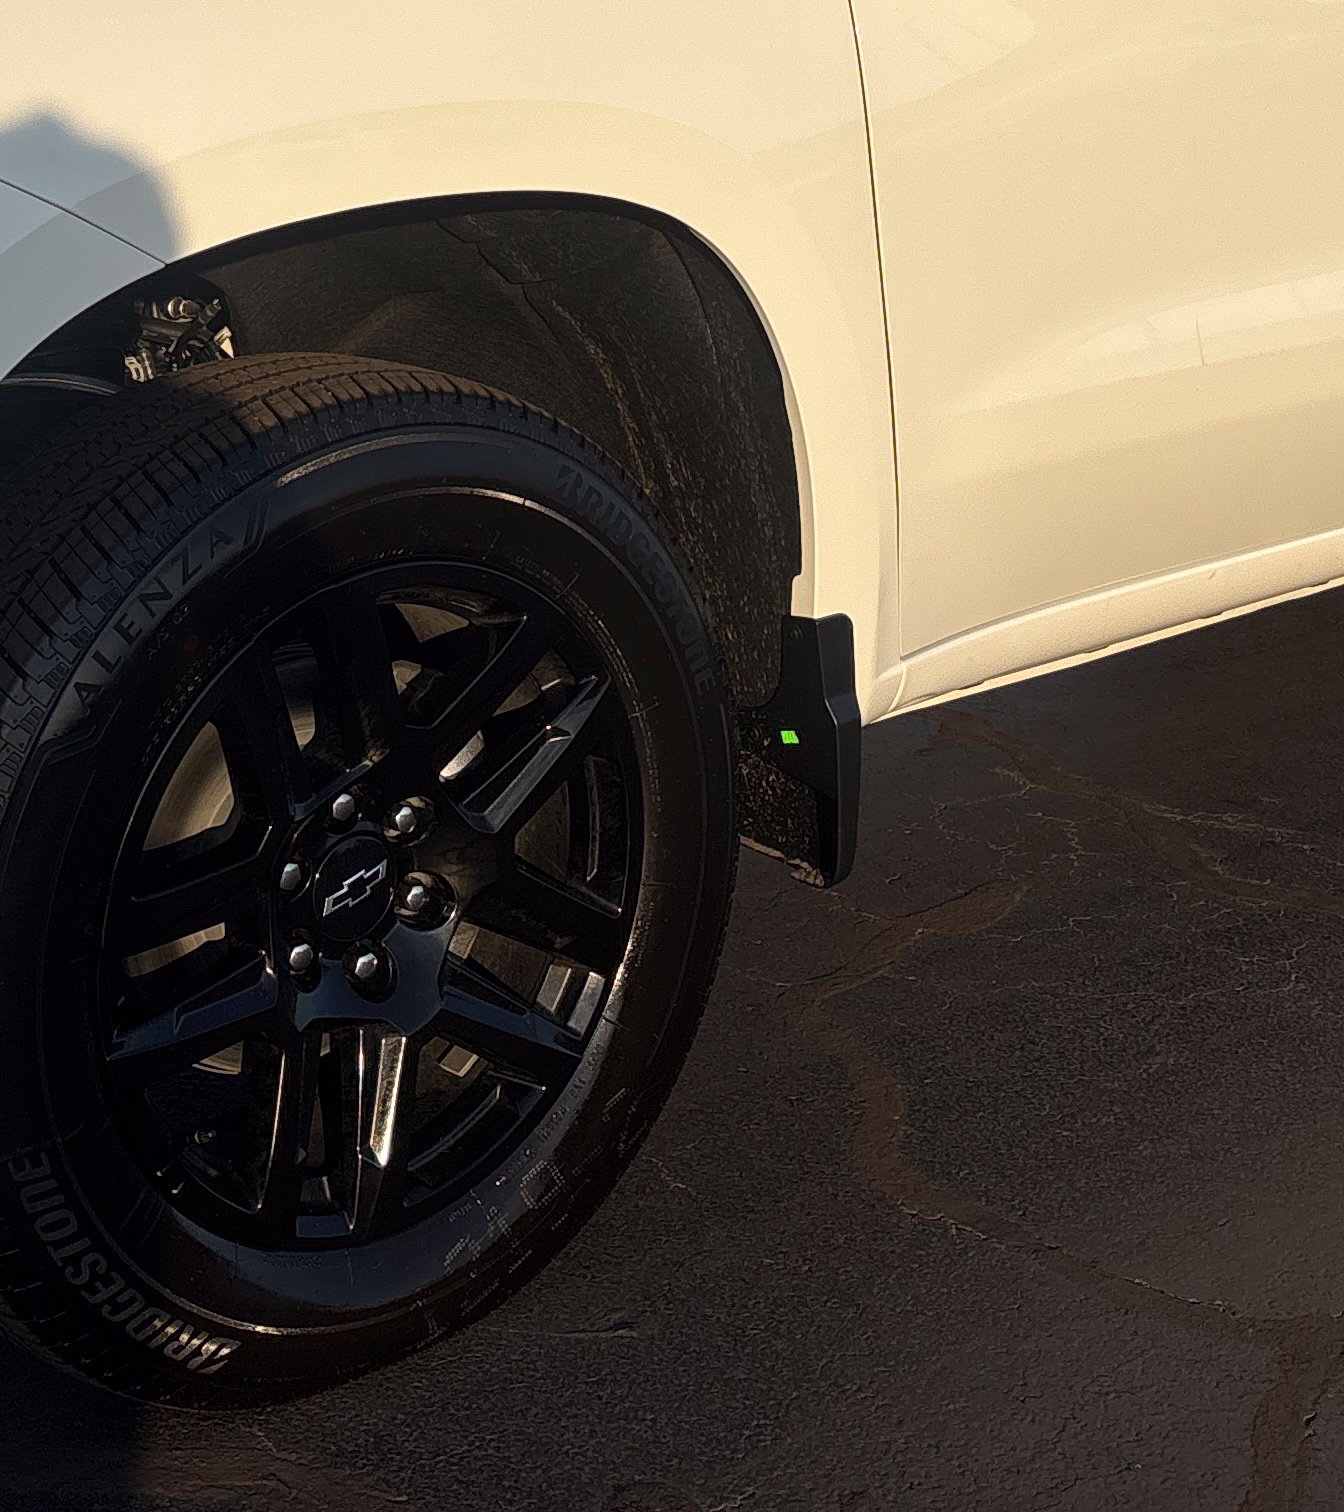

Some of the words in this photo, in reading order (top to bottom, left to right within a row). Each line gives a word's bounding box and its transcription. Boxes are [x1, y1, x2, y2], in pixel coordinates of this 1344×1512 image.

[73, 528, 234, 705] ALENZA
[552, 463, 717, 696] BRIDGESTONE
[7, 1150, 243, 1375] BRIDGESTONE
